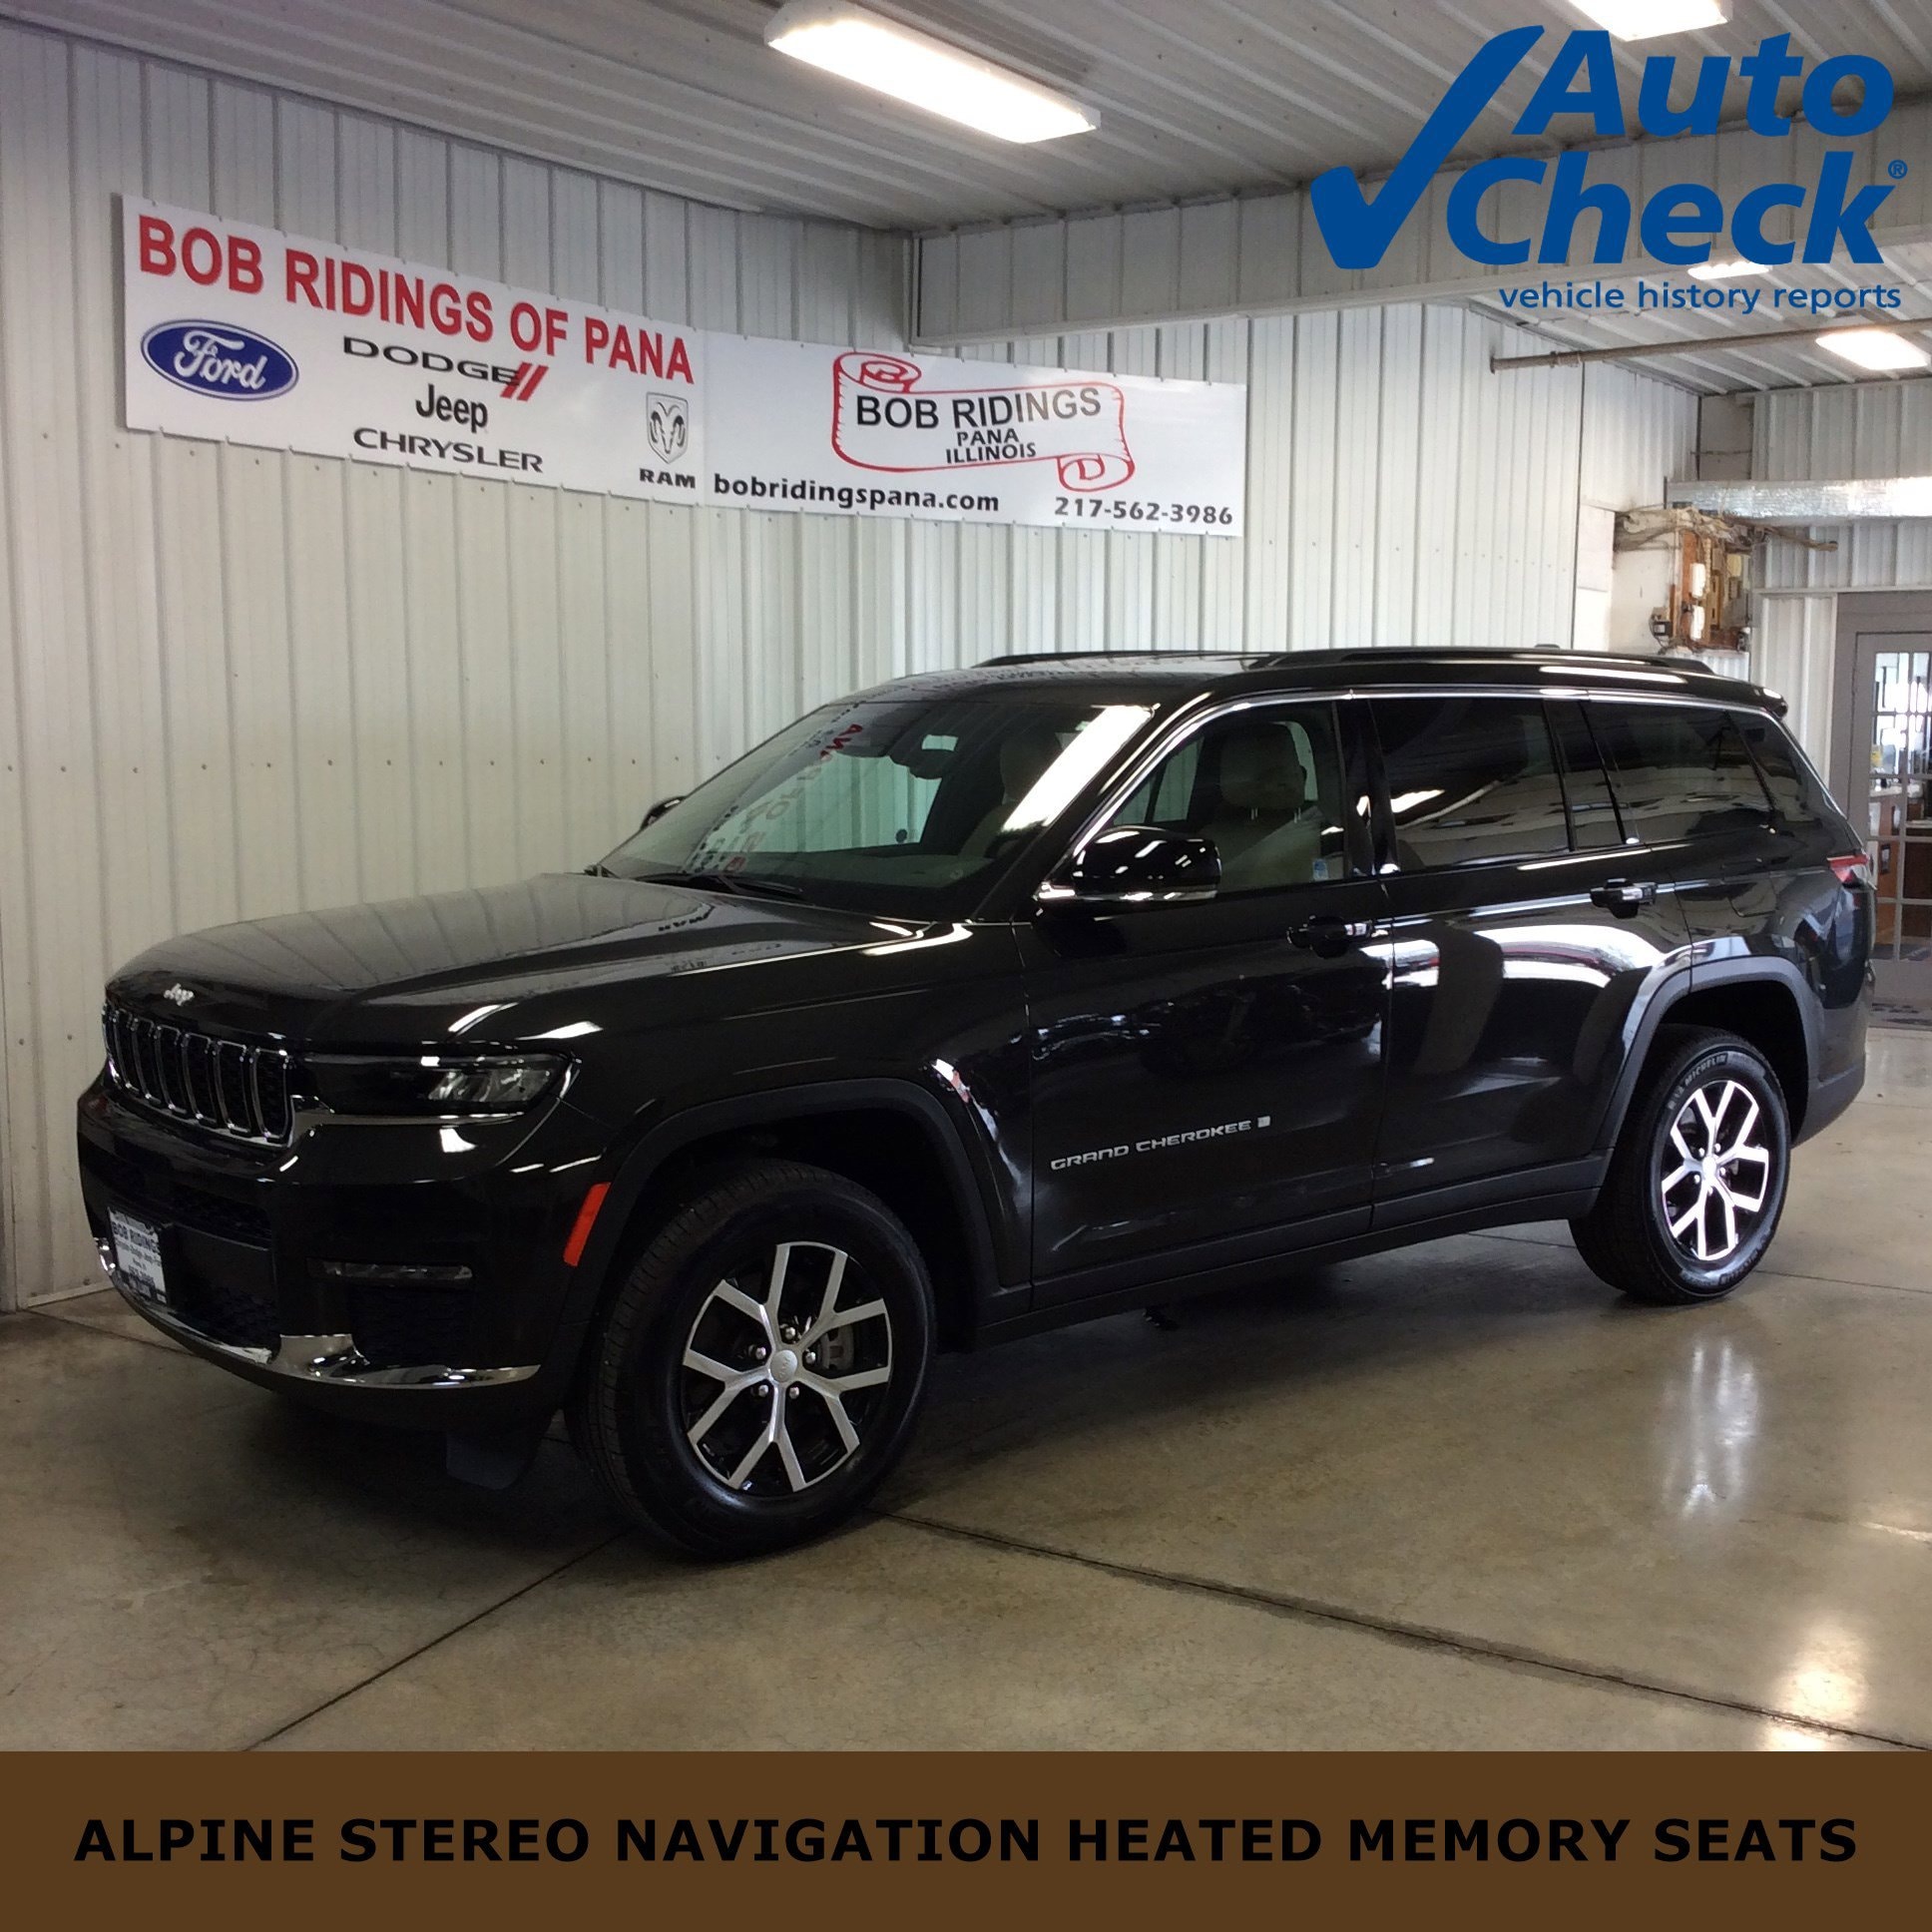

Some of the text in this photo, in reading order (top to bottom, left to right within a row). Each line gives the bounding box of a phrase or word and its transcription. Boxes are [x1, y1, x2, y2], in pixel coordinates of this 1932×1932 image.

[139, 214, 694, 385] BOB RIDINGS OF PANA
[173, 327, 268, 391] Ford
[342, 335, 519, 387] DODGE
[415, 383, 489, 434] Jeep
[855, 386, 1102, 430] BOB RIDINGS
[353, 427, 543, 473] CHRYSLER
[946, 442, 1037, 465] ILLINOIS
[956, 428, 1021, 448] PANA
[639, 468, 698, 489] RAM
[714, 473, 999, 513] bobridingspana.com
[1056, 497, 1233, 525] 217-562-3986
[1050, 1145, 1130, 1171] GRAND
[1136, 1119, 1251, 1153] CHEROKEE
